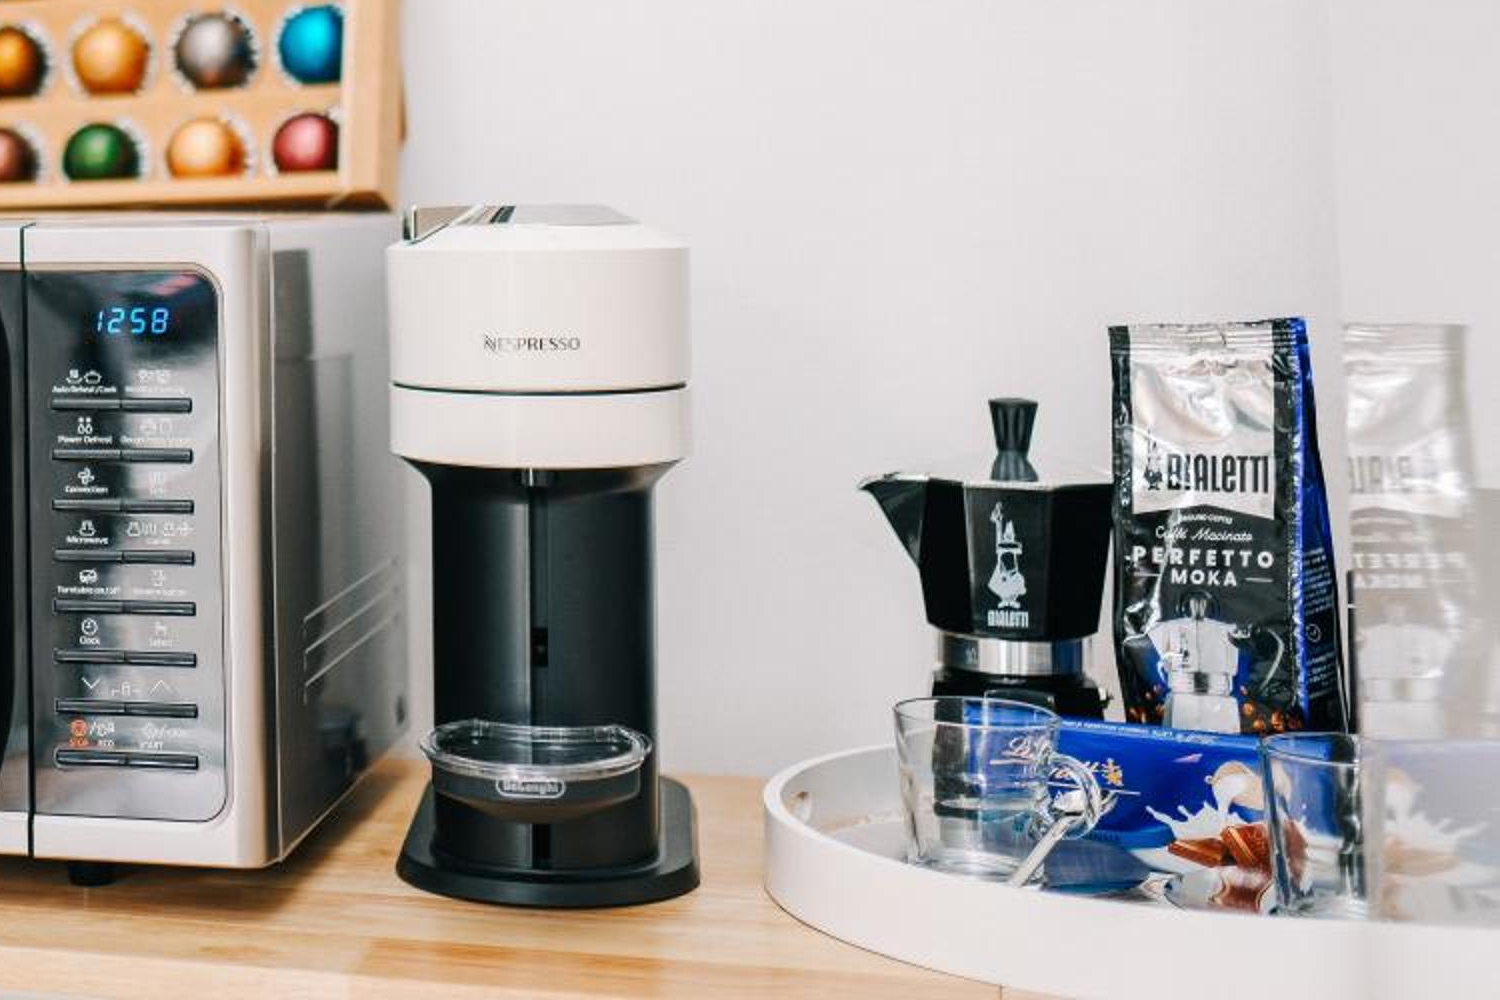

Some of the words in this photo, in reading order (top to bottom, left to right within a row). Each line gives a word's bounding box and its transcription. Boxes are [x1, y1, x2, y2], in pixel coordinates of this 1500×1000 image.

[483, 335, 581, 351] NESPRESSO
[1131, 545, 1274, 569] PERFETTO
[1171, 568, 1237, 587] MOKA
